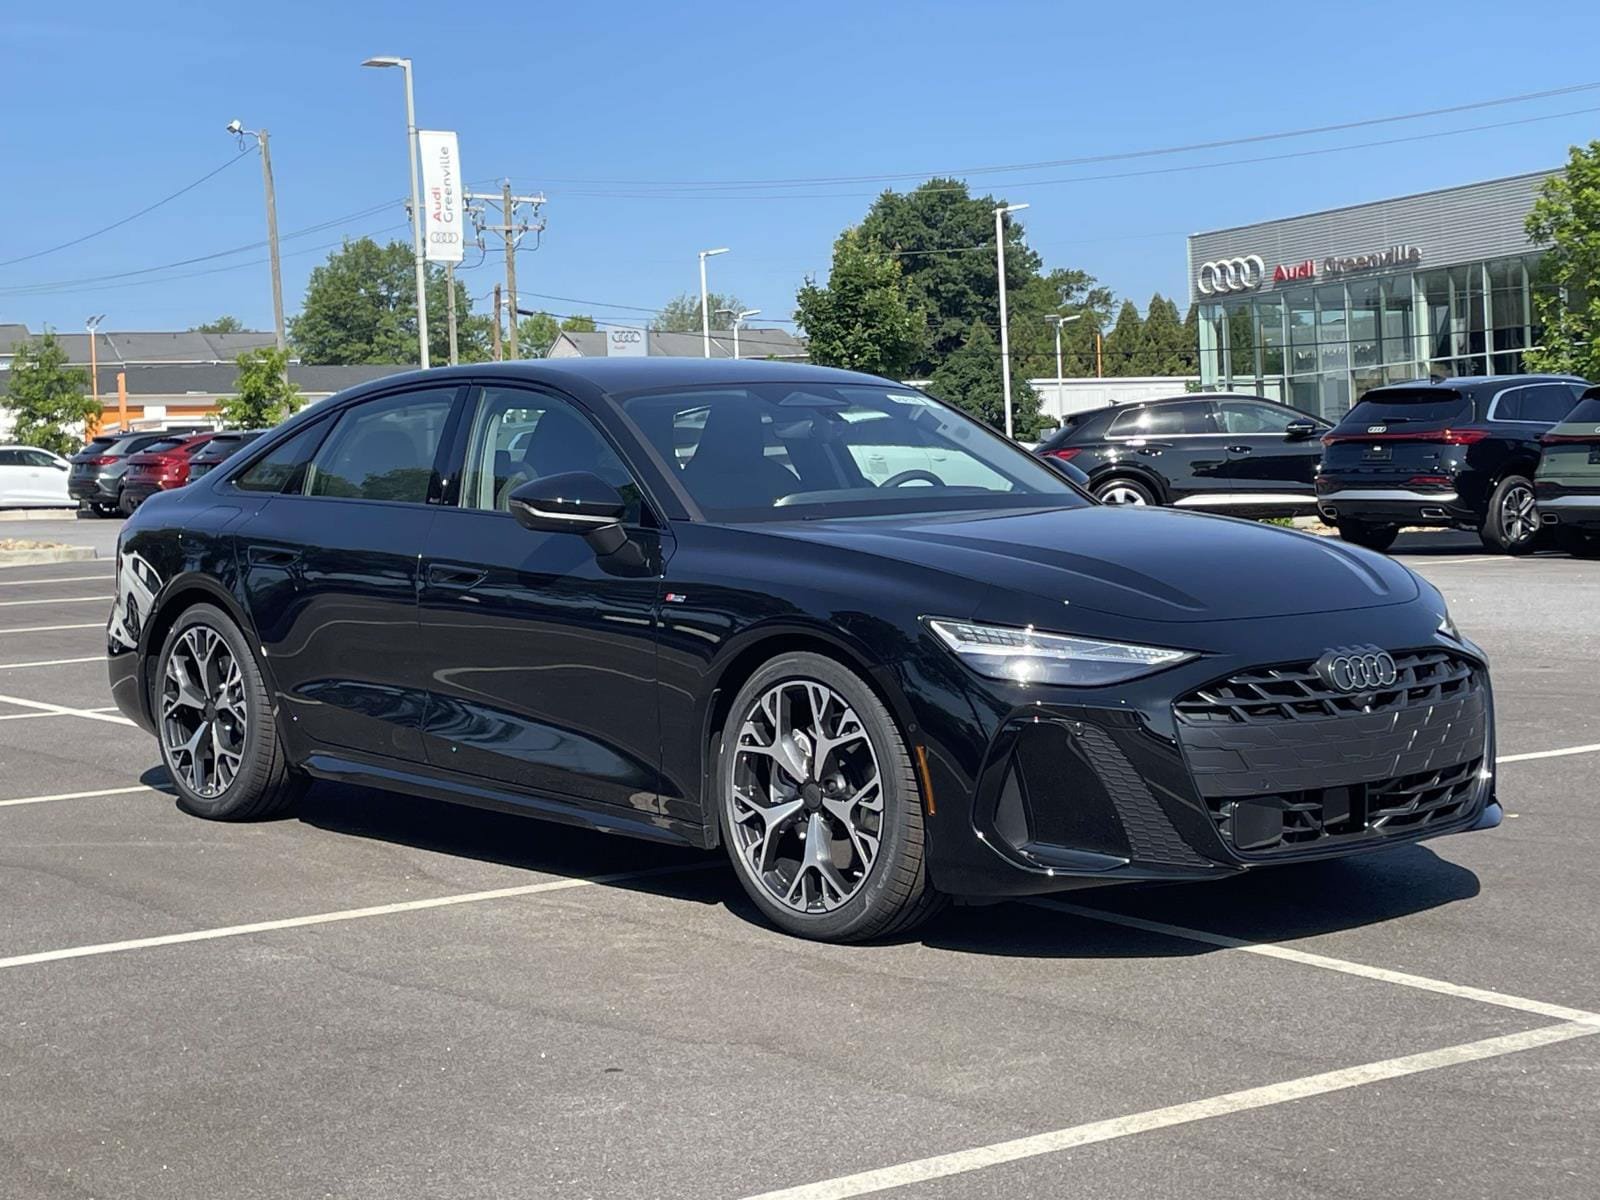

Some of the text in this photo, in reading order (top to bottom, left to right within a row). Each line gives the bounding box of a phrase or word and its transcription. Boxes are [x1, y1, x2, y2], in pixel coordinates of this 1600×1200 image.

[440, 146, 454, 224] Greenville
[431, 187, 442, 223] Audi
[1272, 244, 1423, 282] Audi Greenville
